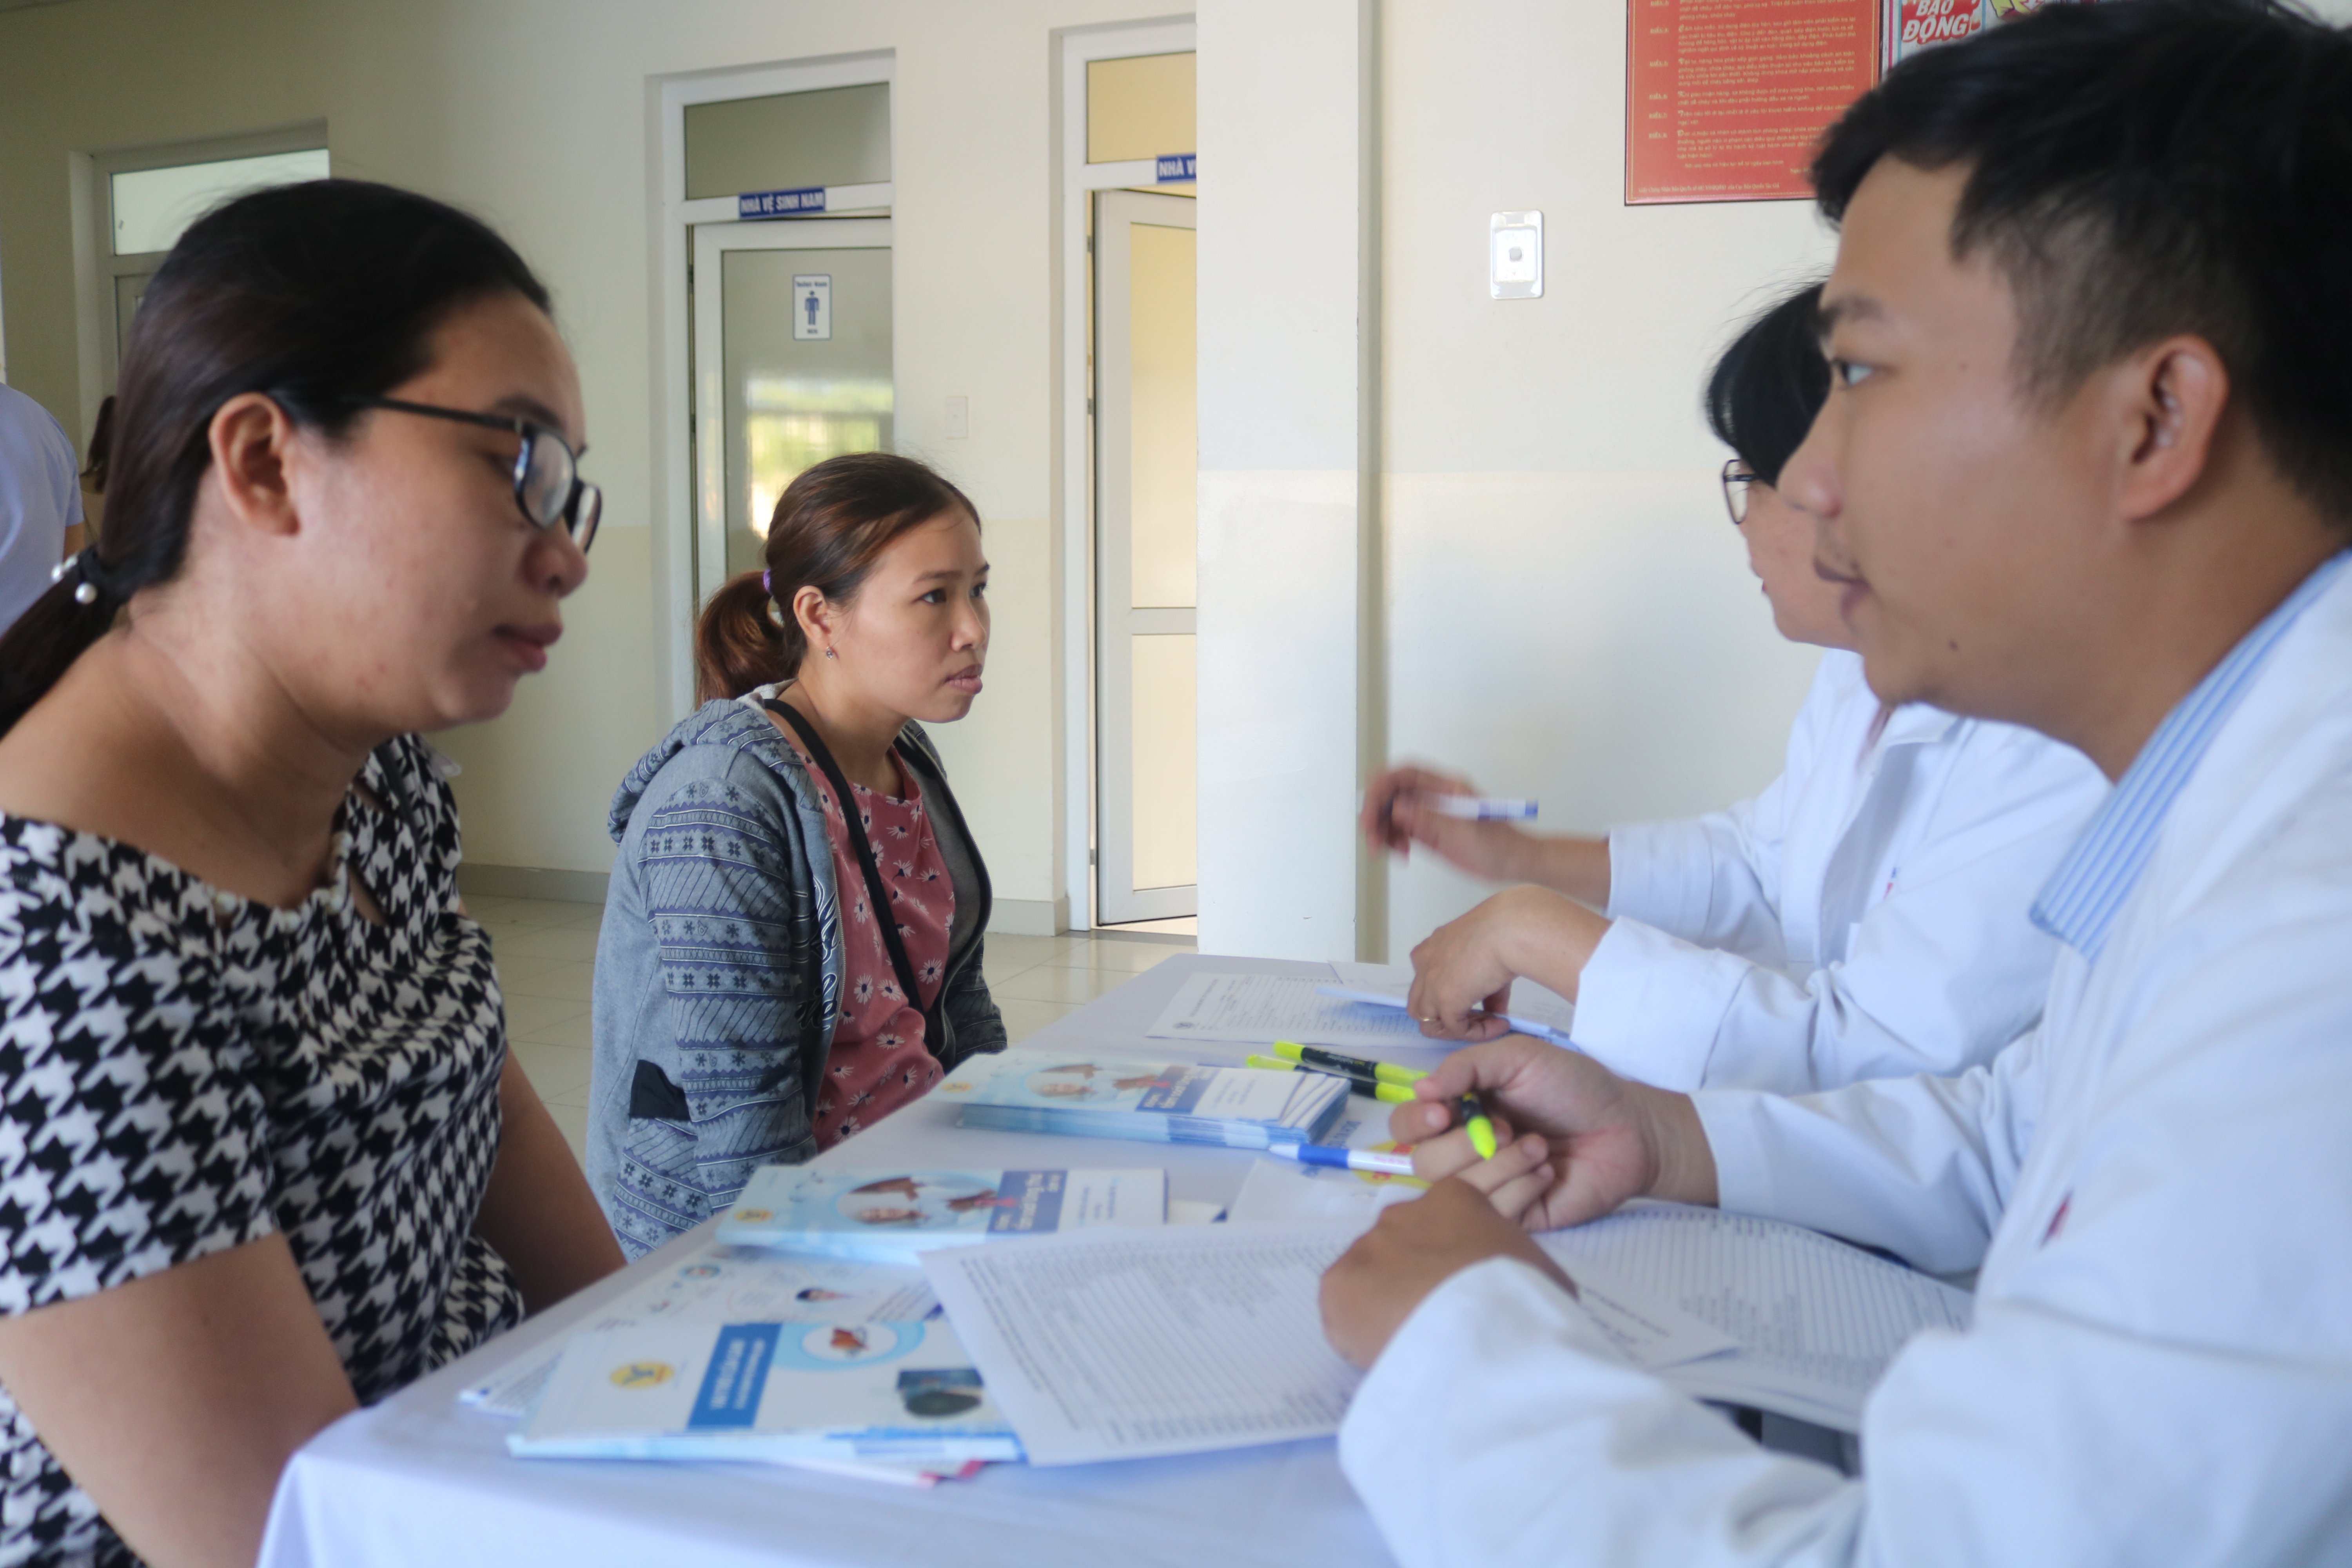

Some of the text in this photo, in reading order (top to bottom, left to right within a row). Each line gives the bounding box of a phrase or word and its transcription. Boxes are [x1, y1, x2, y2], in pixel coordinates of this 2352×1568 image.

[1902, 13, 1969, 42] ĐỘNG
[1159, 157, 1196, 177] NHÀ V
[740, 192, 823, 214] NHÀ VỆ SINH NAM
